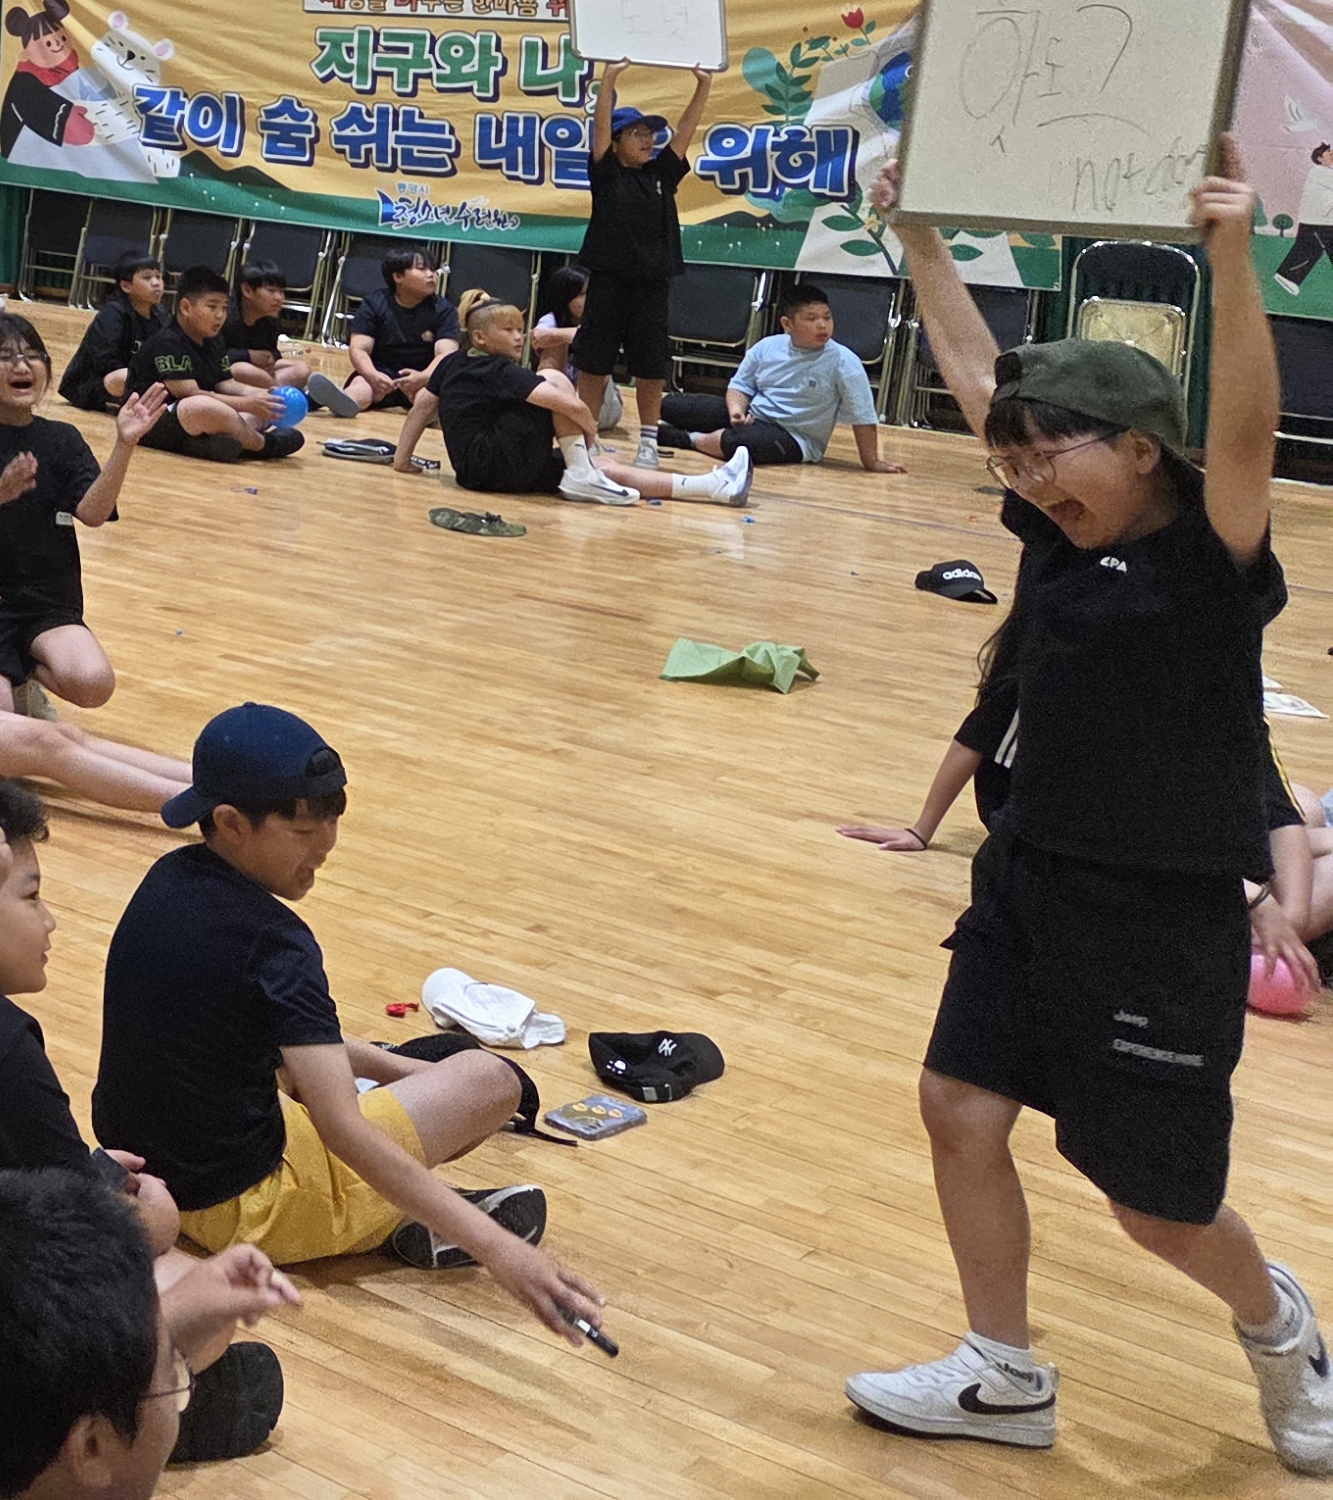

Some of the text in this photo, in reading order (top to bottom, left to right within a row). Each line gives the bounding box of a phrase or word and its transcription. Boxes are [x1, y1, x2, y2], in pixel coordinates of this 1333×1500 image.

[310, 26, 505, 100] 지구와
[133, 84, 242, 157] 같이
[258, 96, 319, 165] 숨
[330, 102, 461, 176] 쉬는
[695, 123, 860, 202] 위해
